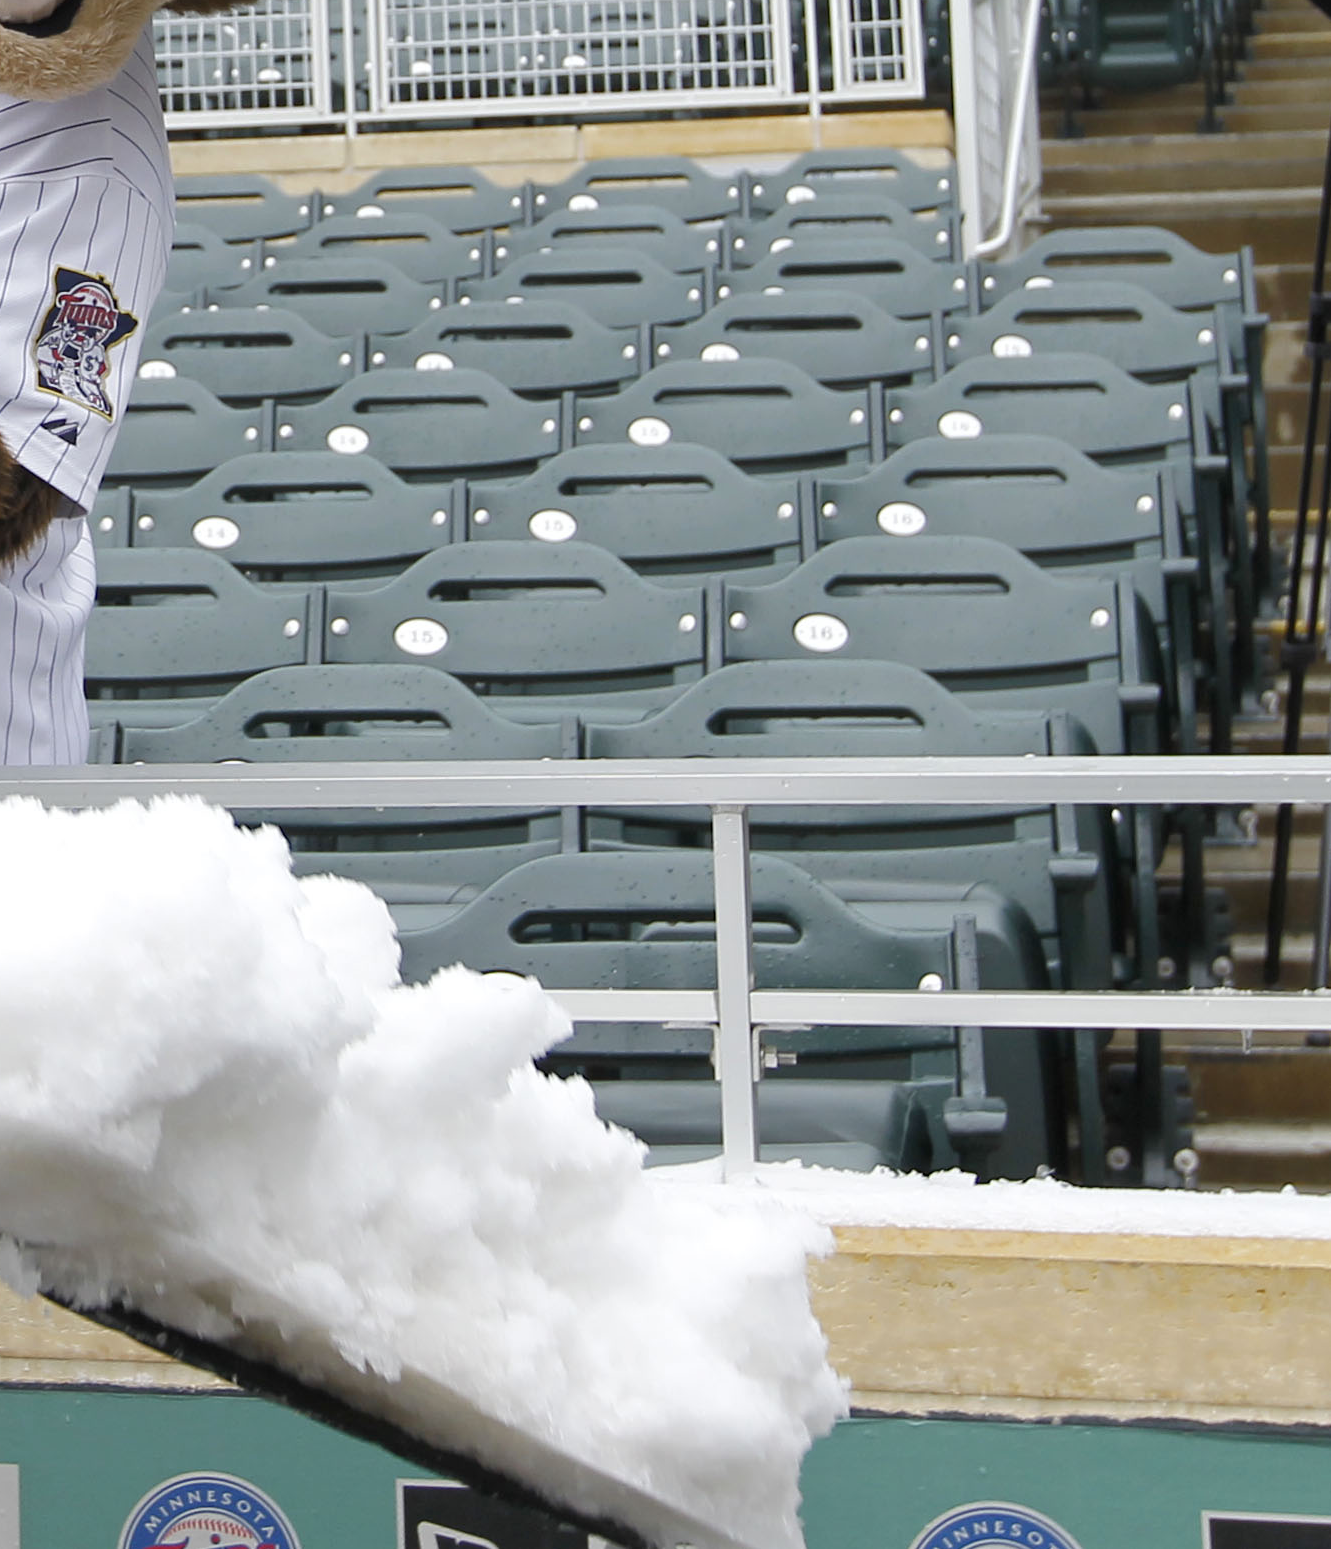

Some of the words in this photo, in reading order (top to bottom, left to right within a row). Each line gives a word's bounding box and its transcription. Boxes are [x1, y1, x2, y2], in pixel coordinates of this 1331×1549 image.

[56, 293, 117, 330] Twins
[206, 527, 225, 540] 14
[412, 629, 433, 643] 15
[810, 626, 833, 641] 16
[144, 1490, 275, 1539] MINNESOTA
[934, 1520, 1060, 1549] INNESO
